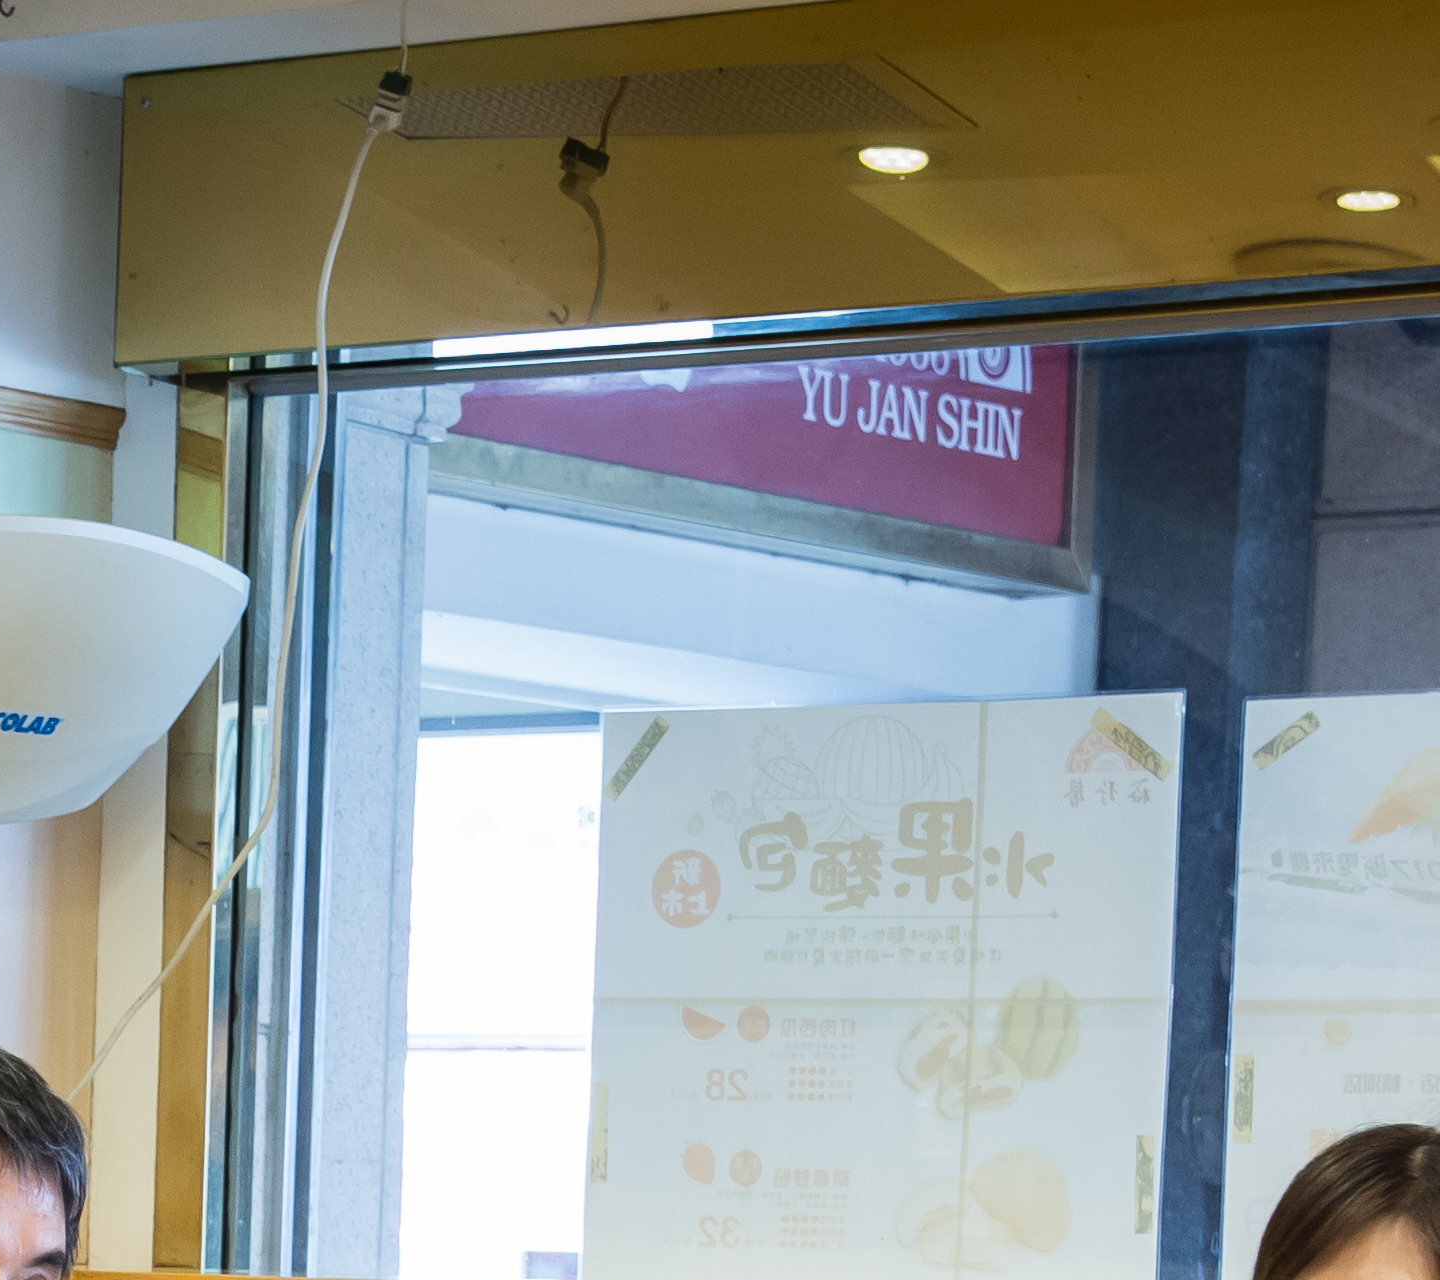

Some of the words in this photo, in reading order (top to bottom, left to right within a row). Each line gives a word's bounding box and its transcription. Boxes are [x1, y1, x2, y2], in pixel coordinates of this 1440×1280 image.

[797, 364, 850, 428] YU
[856, 379, 929, 444] JAN
[936, 394, 1023, 461] SHIN
